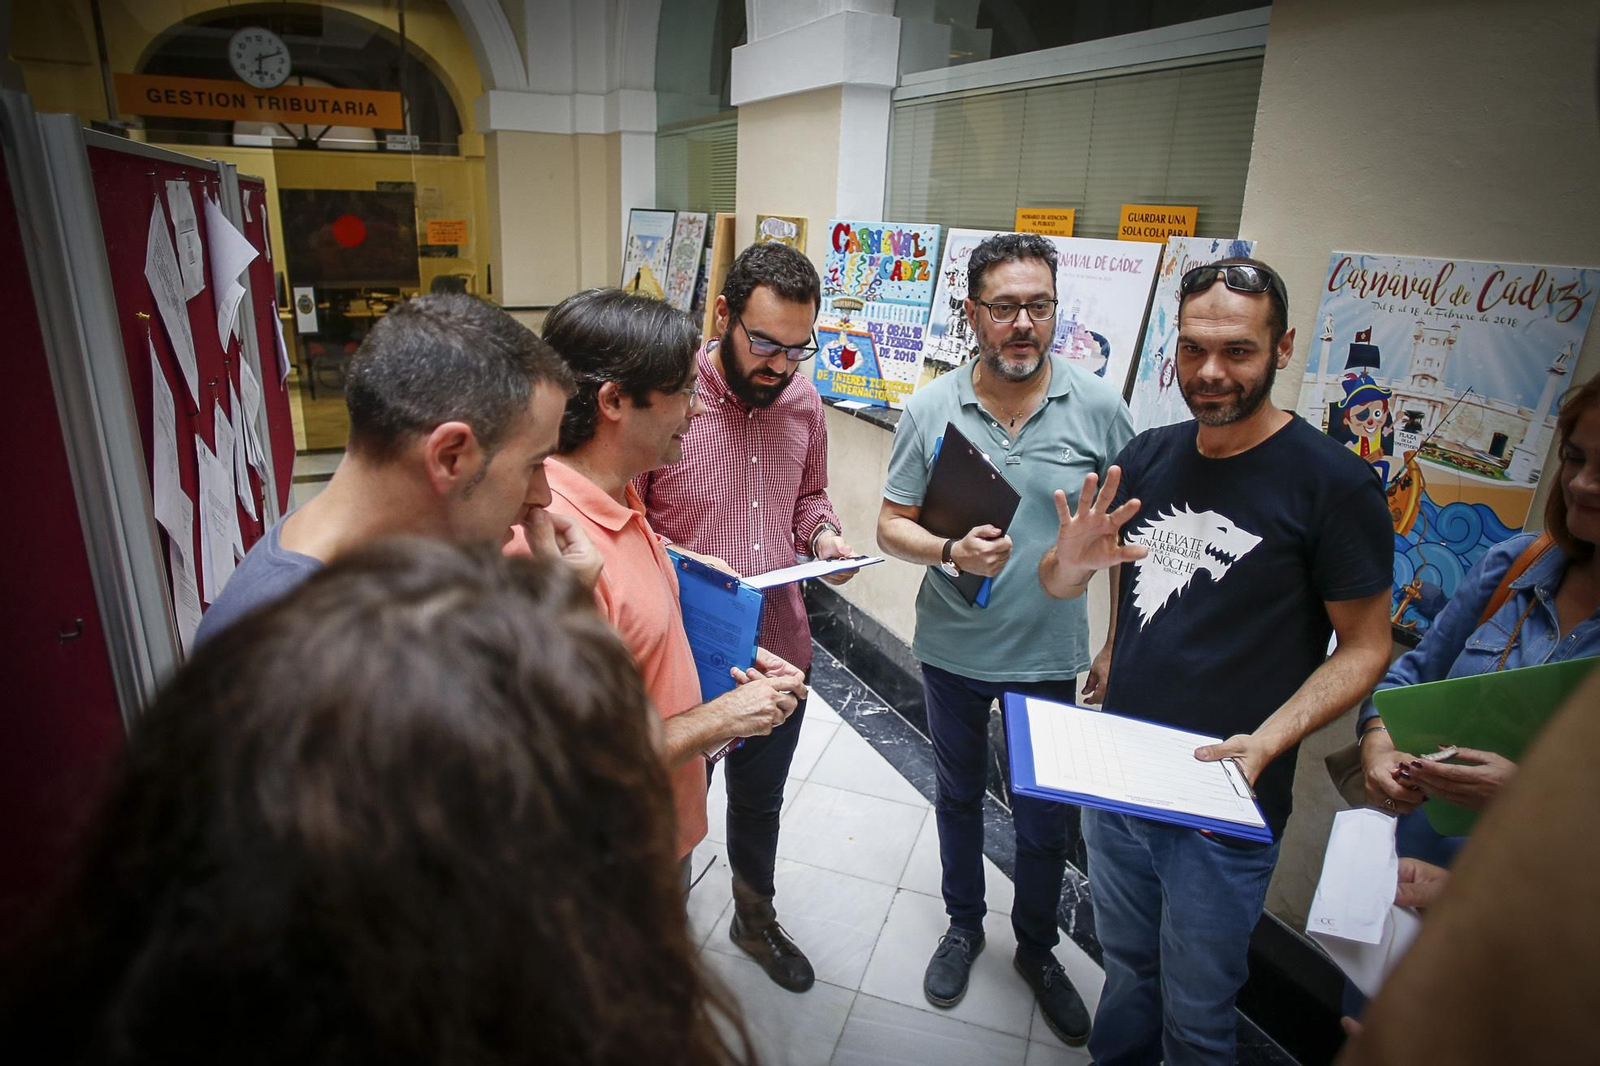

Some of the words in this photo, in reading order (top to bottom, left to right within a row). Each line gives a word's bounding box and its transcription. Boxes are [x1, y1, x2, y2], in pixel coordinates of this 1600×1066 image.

[146, 88, 246, 109] GESTION
[254, 95, 378, 116] TRIBUTARIA
[1128, 212, 1166, 224] GUARDAR
[1168, 214, 1187, 225] UNA
[832, 222, 927, 258] CARNAVAL
[1122, 225, 1142, 237] SOLA
[1143, 227, 1165, 238] COLA
[1167, 229, 1188, 237] PARA
[1057, 251, 1091, 269] RNAVAL
[1094, 255, 1108, 271] DE
[1109, 253, 1143, 274] CÁDIZ
[1327, 256, 1455, 307] Carnaval
[1449, 284, 1472, 307] de
[1476, 268, 1592, 324] Cádiz
[1371, 301, 1387, 311] Del
[1388, 305, 1394, 313] 8
[1398, 305, 1407, 313] al
[1410, 306, 1420, 316] 18
[1423, 308, 1433, 316] de
[1434, 307, 1476, 321] Febrero
[1478, 313, 1489, 323] de
[1493, 316, 1520, 328] 2018
[867, 321, 885, 335] DEL
[900, 325, 912, 338] AL
[873, 333, 886, 346] DE
[879, 347, 891, 359] DE
[893, 349, 917, 363] 2018
[817, 368, 829, 380] DE
[1139, 537, 1157, 548] UNA
[1159, 542, 1201, 560] REBEQUITA
[1151, 528, 1204, 552] LLÉVATE
[1152, 553, 1196, 574] NOCHE
